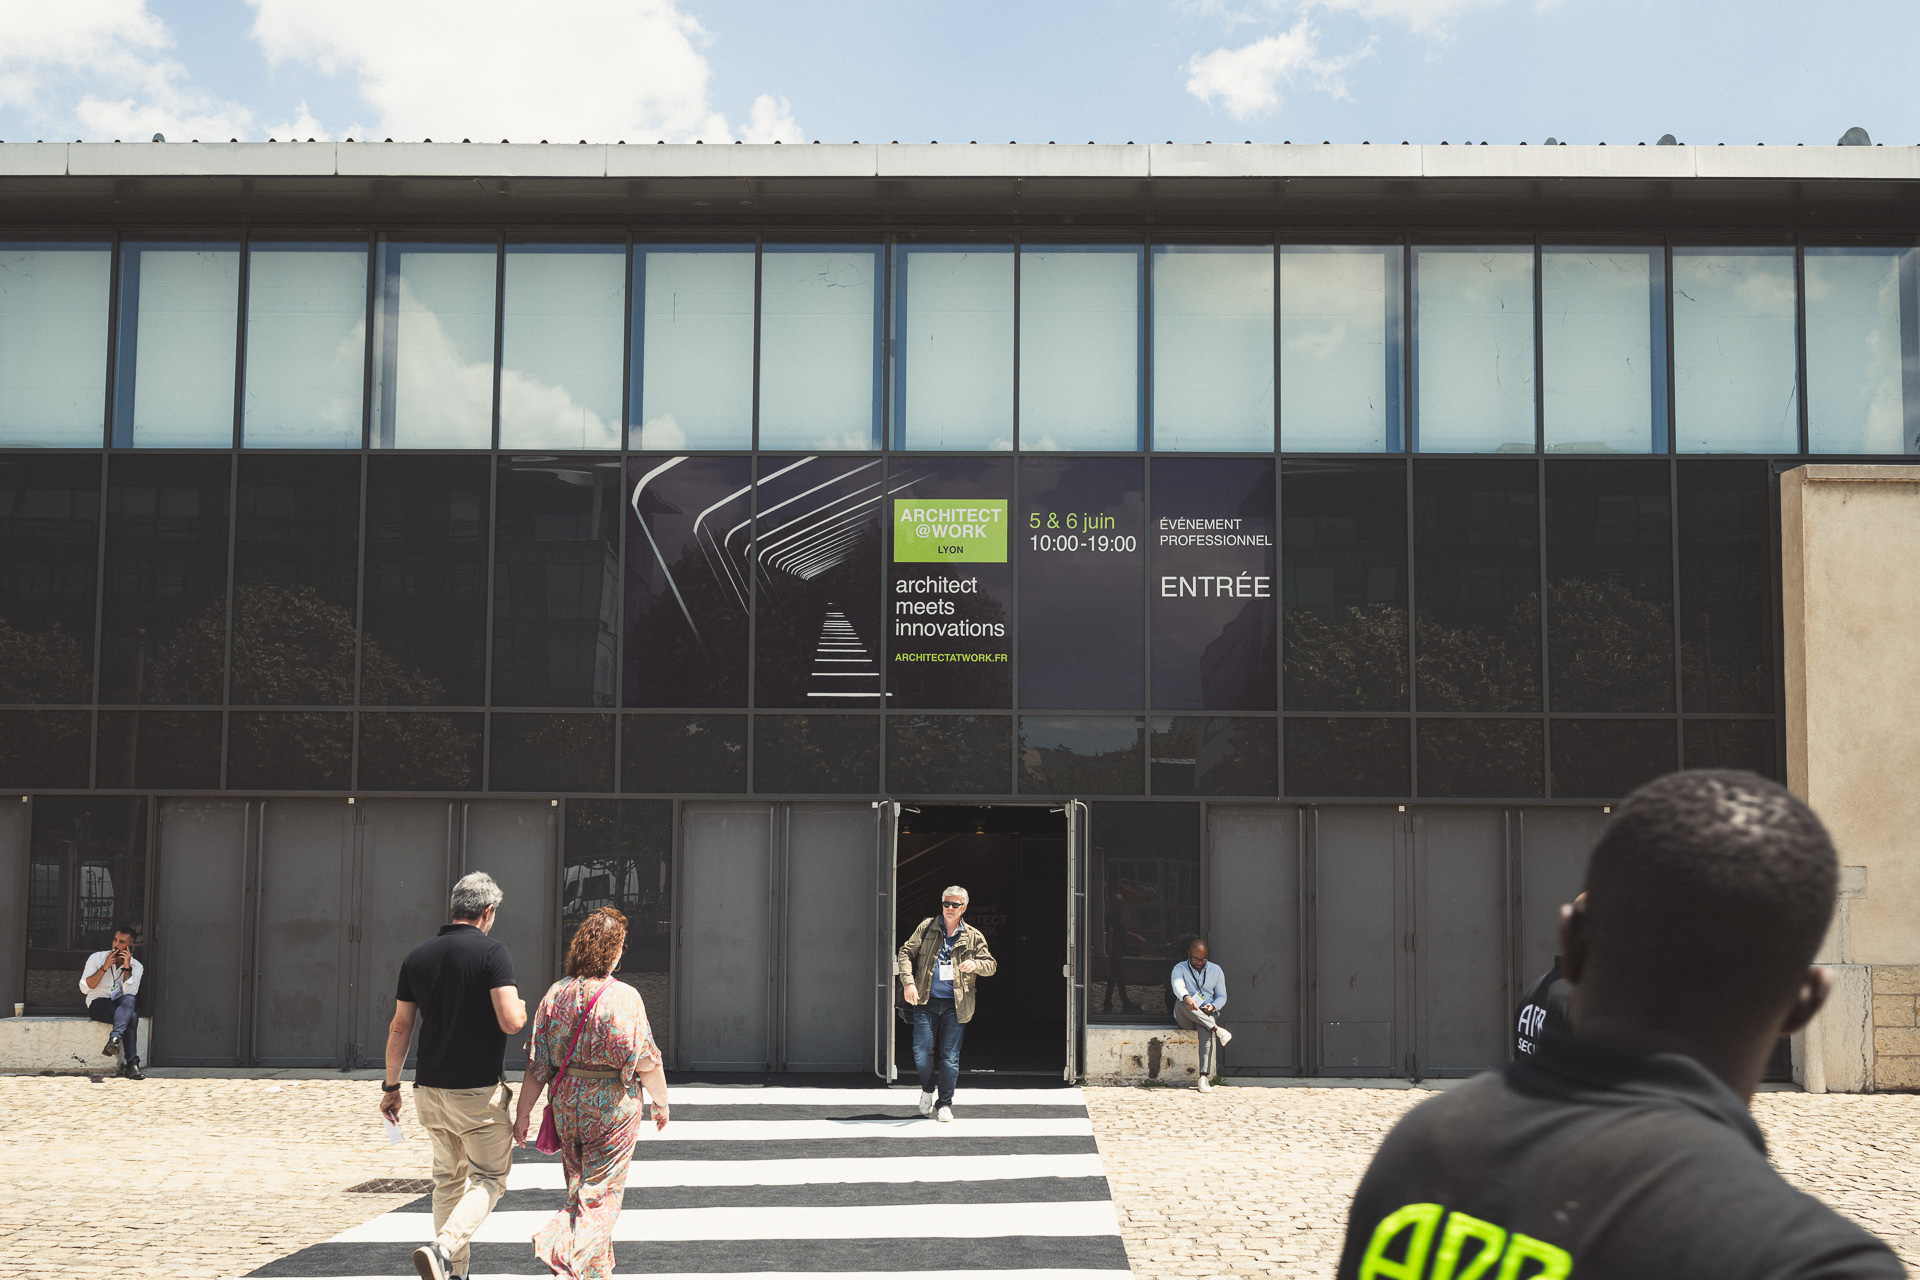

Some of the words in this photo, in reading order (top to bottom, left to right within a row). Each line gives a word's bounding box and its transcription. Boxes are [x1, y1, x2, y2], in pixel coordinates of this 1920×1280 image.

[900, 508, 1002, 523] ARCHITECT
[1029, 512, 1041, 529] 5
[1046, 512, 1060, 529] &
[1066, 512, 1078, 529] 6
[1082, 512, 1115, 533] juin
[1160, 516, 1242, 530] ÉVÉNEMENT
[915, 523, 987, 539] @WORK
[1030, 534, 1137, 552] 10:00-19:00
[1160, 534, 1272, 546] PROFESSIONNEL
[937, 545, 964, 554] LYON
[895, 575, 978, 594] architect
[1161, 570, 1271, 598] ENTRÉE
[895, 598, 955, 615] meets
[895, 618, 1005, 637] innovations
[894, 653, 1008, 662] ARCHITECTATWORK.FR
